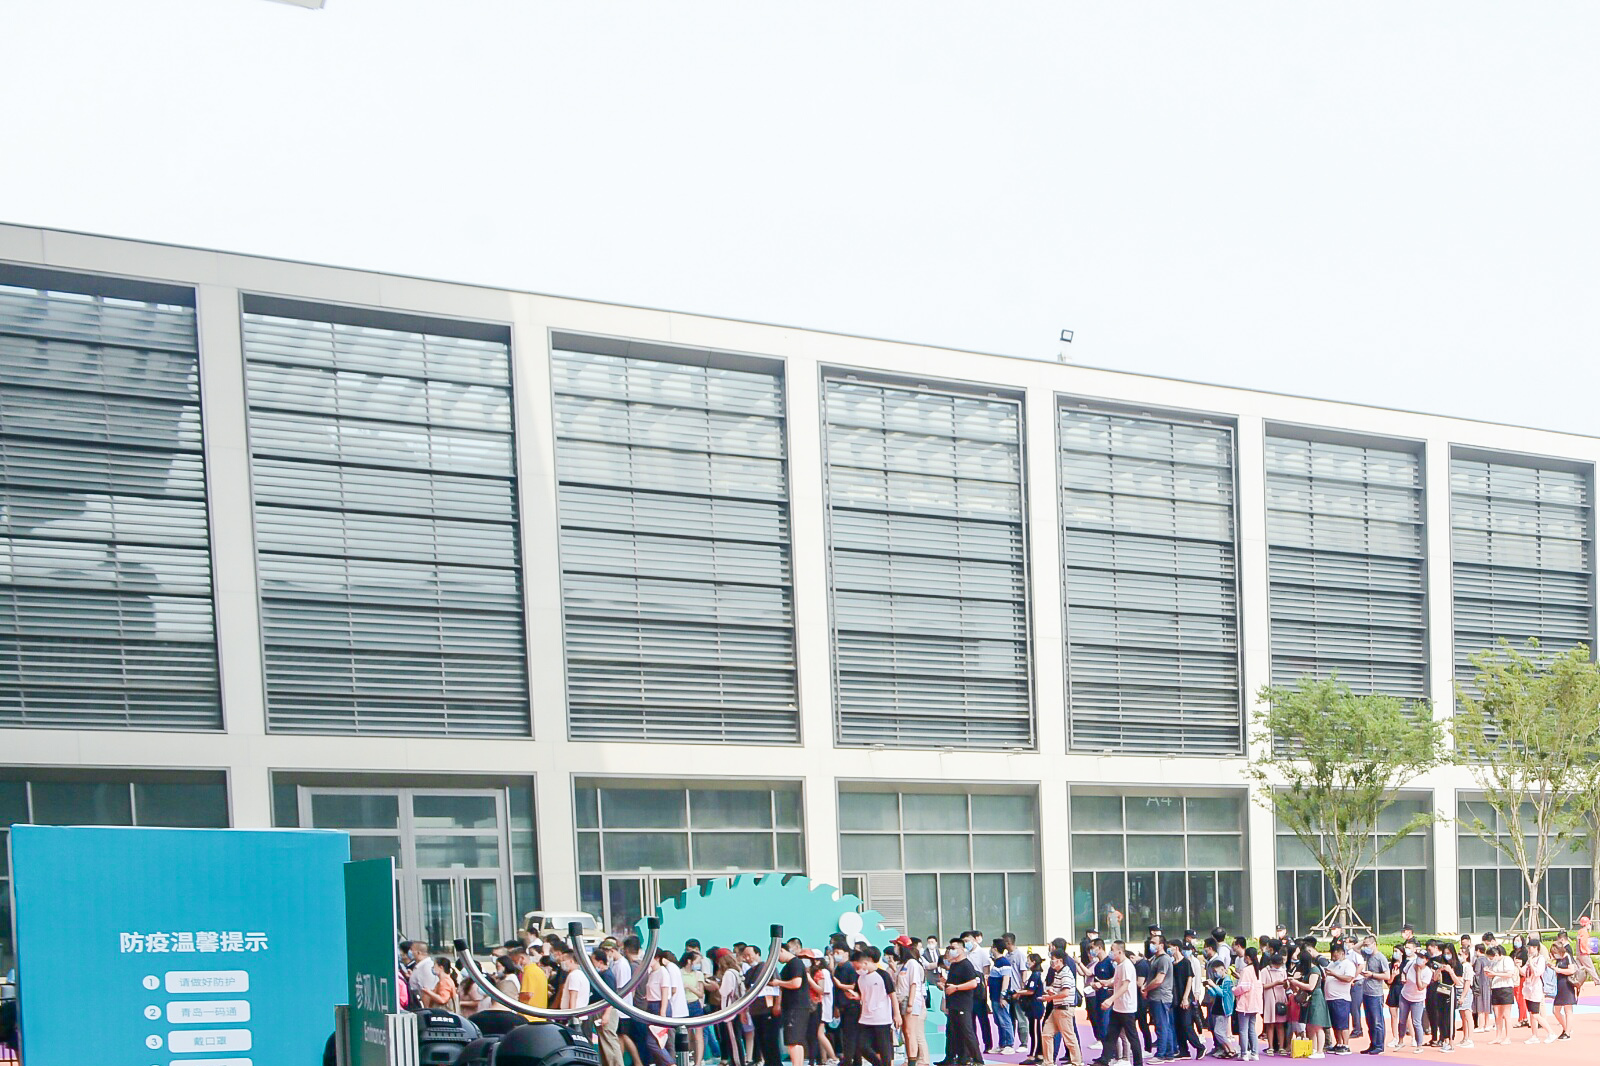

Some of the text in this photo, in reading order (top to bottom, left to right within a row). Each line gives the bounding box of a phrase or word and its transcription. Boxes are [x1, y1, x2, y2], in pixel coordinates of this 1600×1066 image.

[119, 931, 269, 953] 防疫温馨提示
[179, 977, 236, 987] 请做好防护
[355, 972, 389, 1012] 参观入口
[181, 1007, 237, 1018] 青岛一码通
[193, 1036, 227, 1046] 戴口罩
